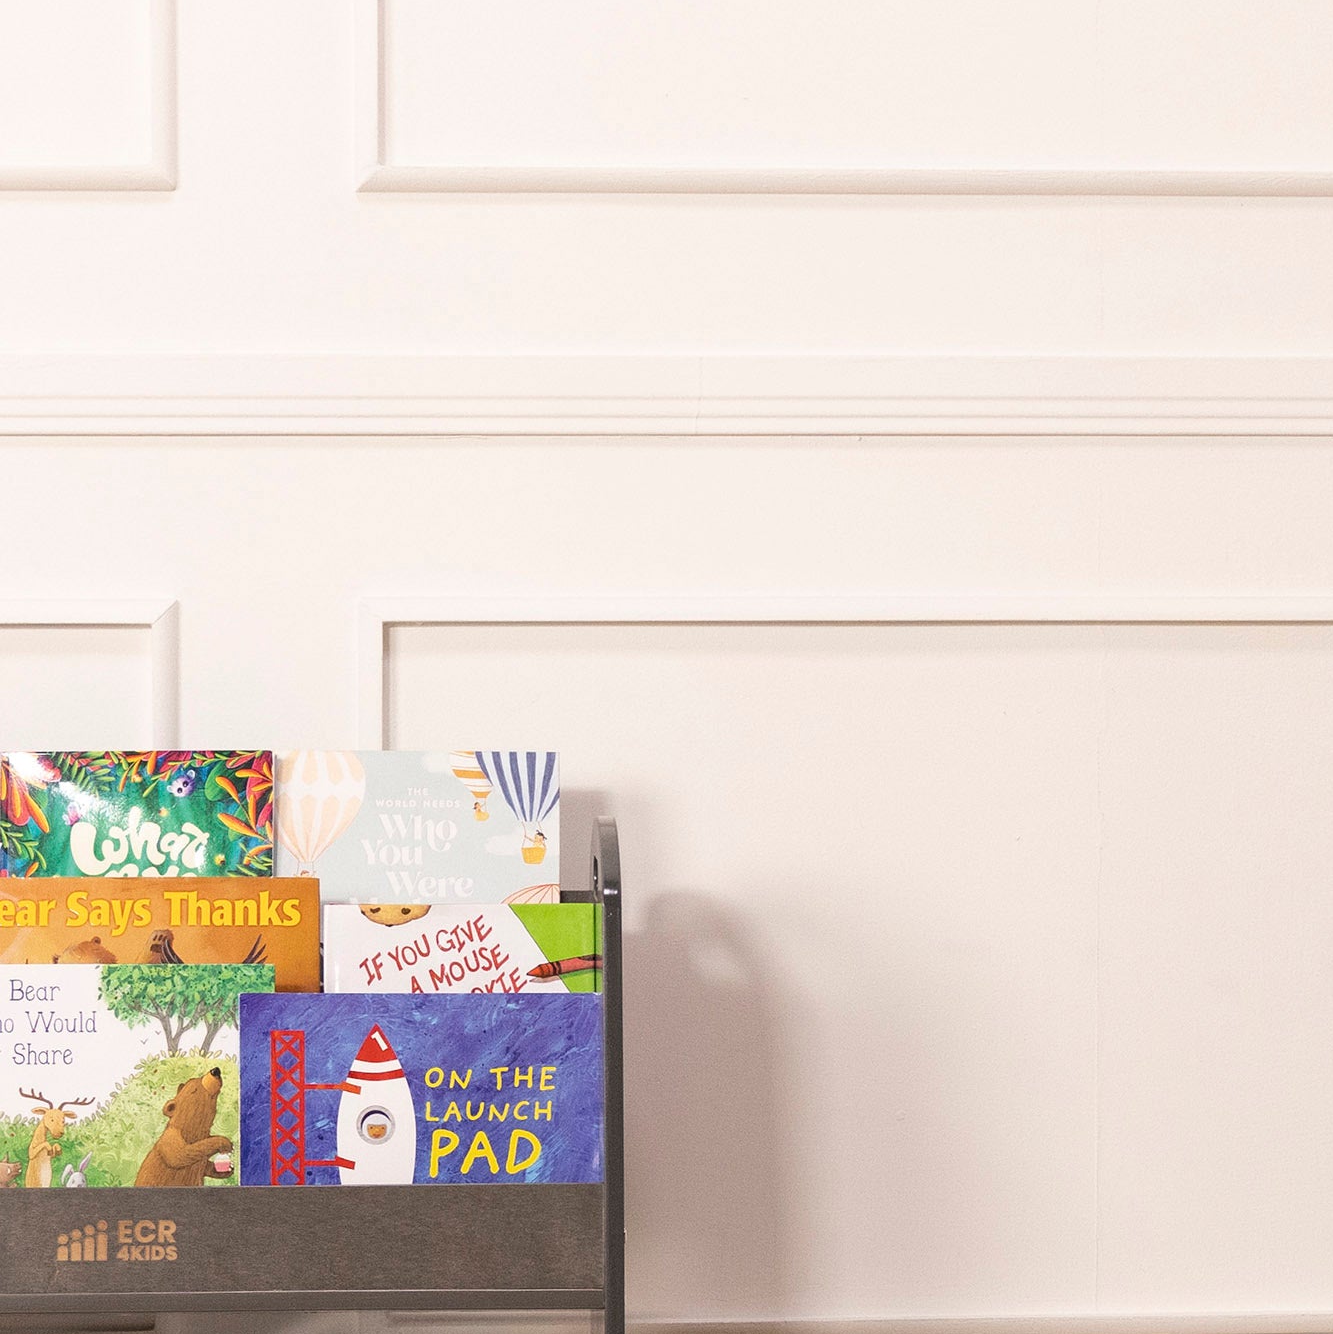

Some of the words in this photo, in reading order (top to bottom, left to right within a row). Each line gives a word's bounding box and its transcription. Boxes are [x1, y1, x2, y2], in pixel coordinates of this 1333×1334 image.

[407, 787, 429, 796] THE
[375, 799, 417, 809] WORLD
[423, 799, 461, 809] NEEDS
[378, 814, 458, 852] Who
[360, 839, 424, 867] You
[385, 870, 474, 898] Were
[66, 891, 152, 936] Says
[164, 890, 302, 927] Thanks
[359, 952, 383, 986] IF
[388, 933, 431, 971] YOU
[436, 915, 493, 953] GIVE
[411, 976, 424, 993] A
[428, 944, 509, 991] MOUSE
[9, 979, 60, 1001] Bear
[25, 1011, 97, 1033] Would
[371, 1031, 388, 1051] 1
[12, 1043, 73, 1065] Share
[424, 1066, 472, 1090] ON
[489, 1066, 556, 1091] THE
[425, 1100, 553, 1122] LAUNCH
[429, 1129, 542, 1178] PAD
[117, 1219, 177, 1243] ECR
[116, 1245, 178, 1261] 4KIDS
